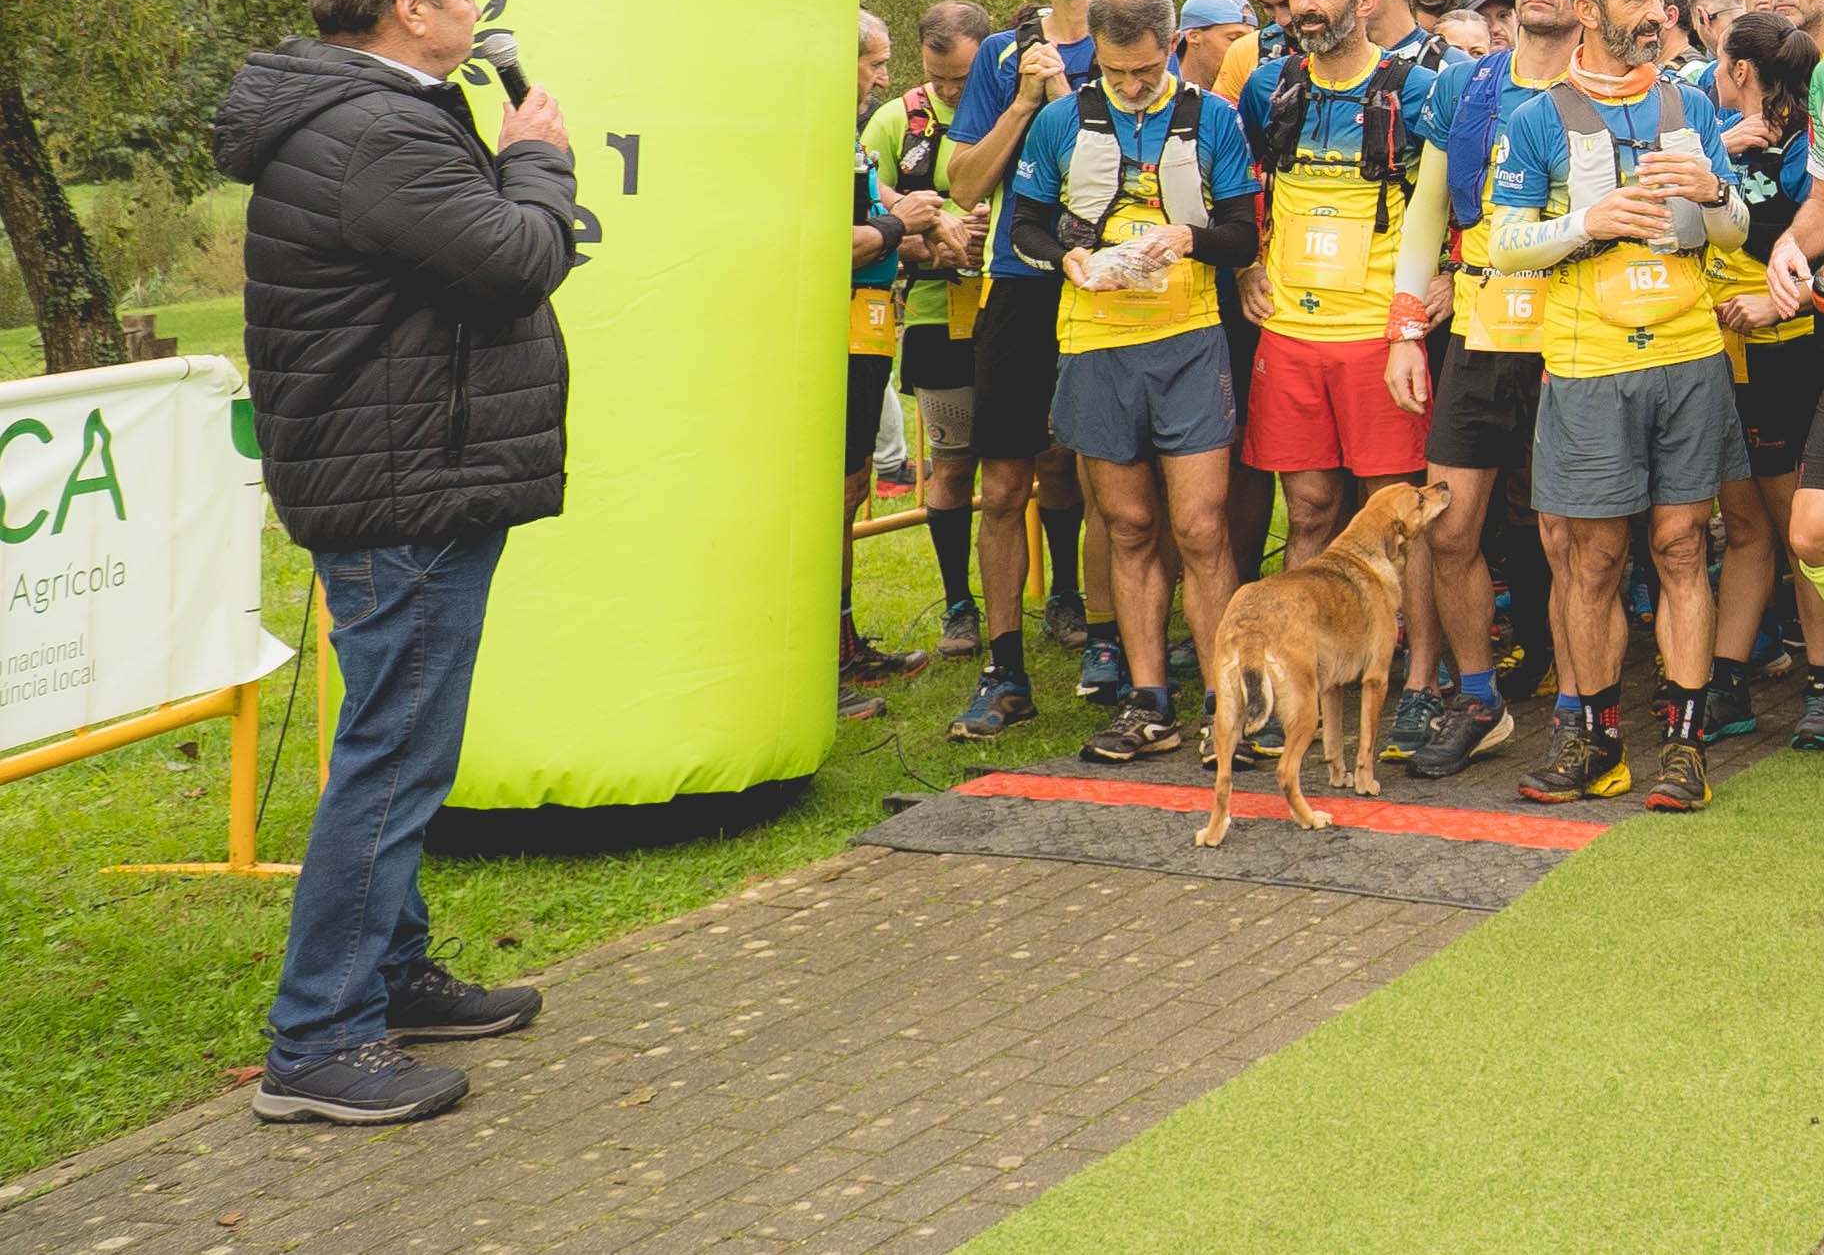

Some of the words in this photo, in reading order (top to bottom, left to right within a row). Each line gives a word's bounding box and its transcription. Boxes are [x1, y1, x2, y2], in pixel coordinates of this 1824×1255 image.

[1305, 232, 1338, 256] 116
[1624, 266, 1670, 291] 182
[1505, 293, 1533, 318] 16
[8, 554, 127, 614] Agrícola
[8, 632, 86, 675] nacional
[53, 657, 96, 692] local
